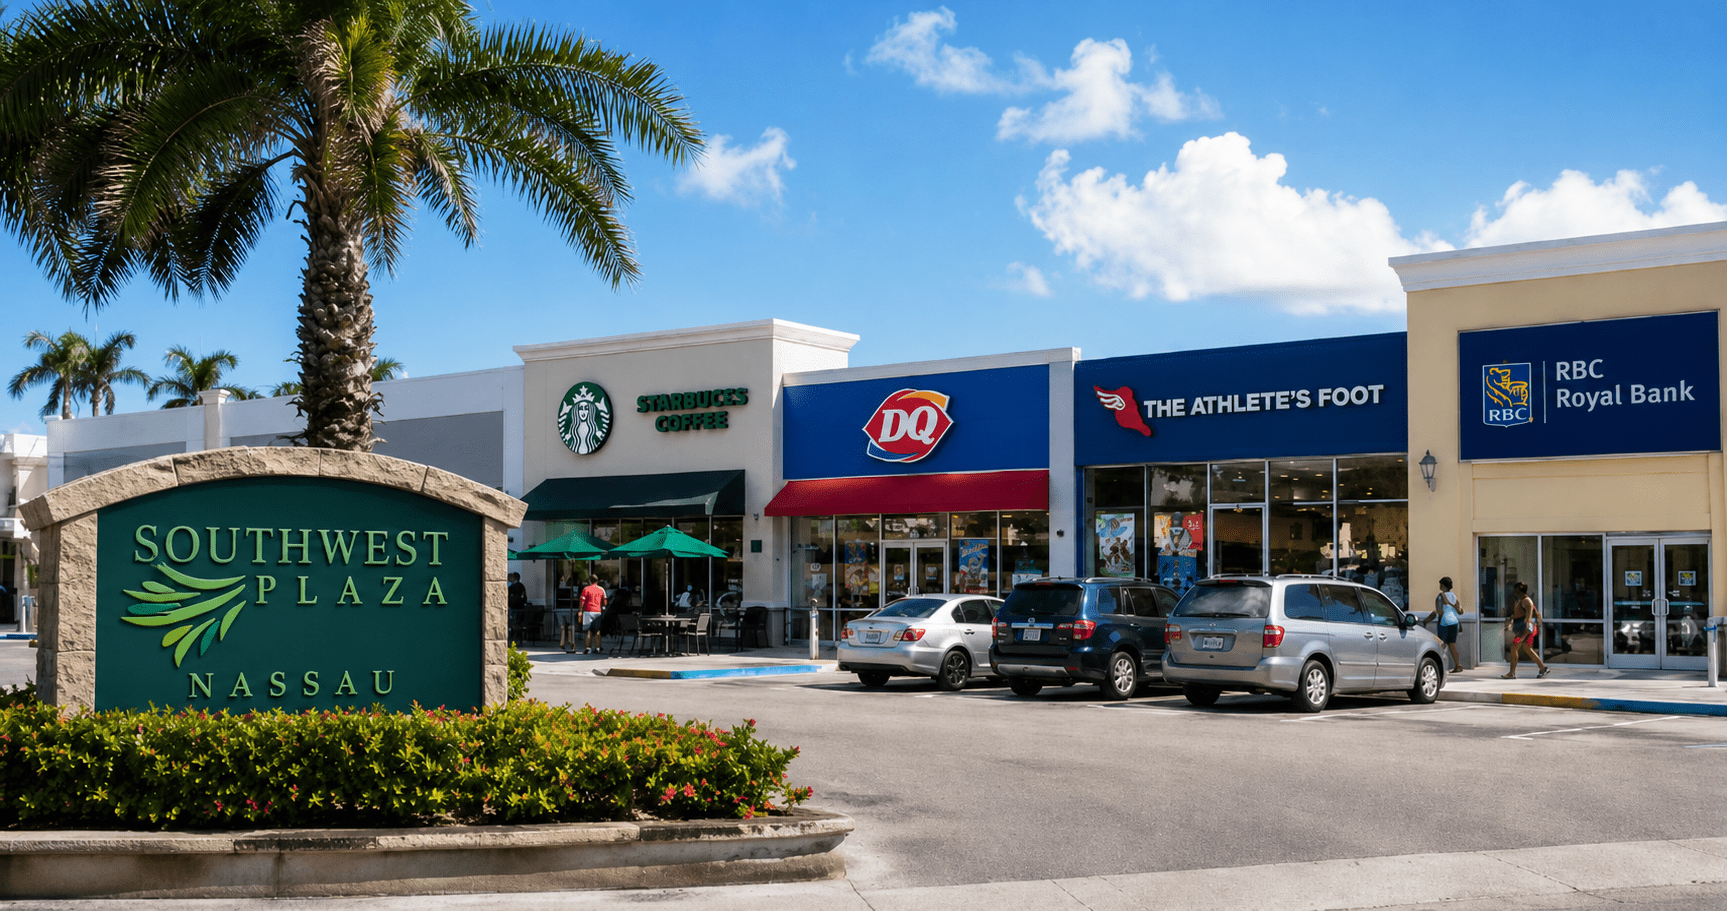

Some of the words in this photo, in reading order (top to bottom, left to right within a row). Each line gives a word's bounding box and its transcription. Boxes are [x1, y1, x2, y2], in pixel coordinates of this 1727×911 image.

[1556, 358, 1604, 381] RBC
[1143, 398, 1186, 418] THE
[1190, 388, 1312, 416] ATHLETE’S
[1318, 384, 1385, 408] FOOT
[1556, 384, 1622, 412] Royal
[1630, 379, 1695, 404] Bank
[655, 410, 729, 433] COFFEE
[878, 405, 939, 445] DQ
[1488, 407, 1528, 422] RBC
[134, 524, 449, 566] SOUTHWEST
[255, 575, 448, 605] PLAZA
[188, 669, 395, 699] NASSAU
